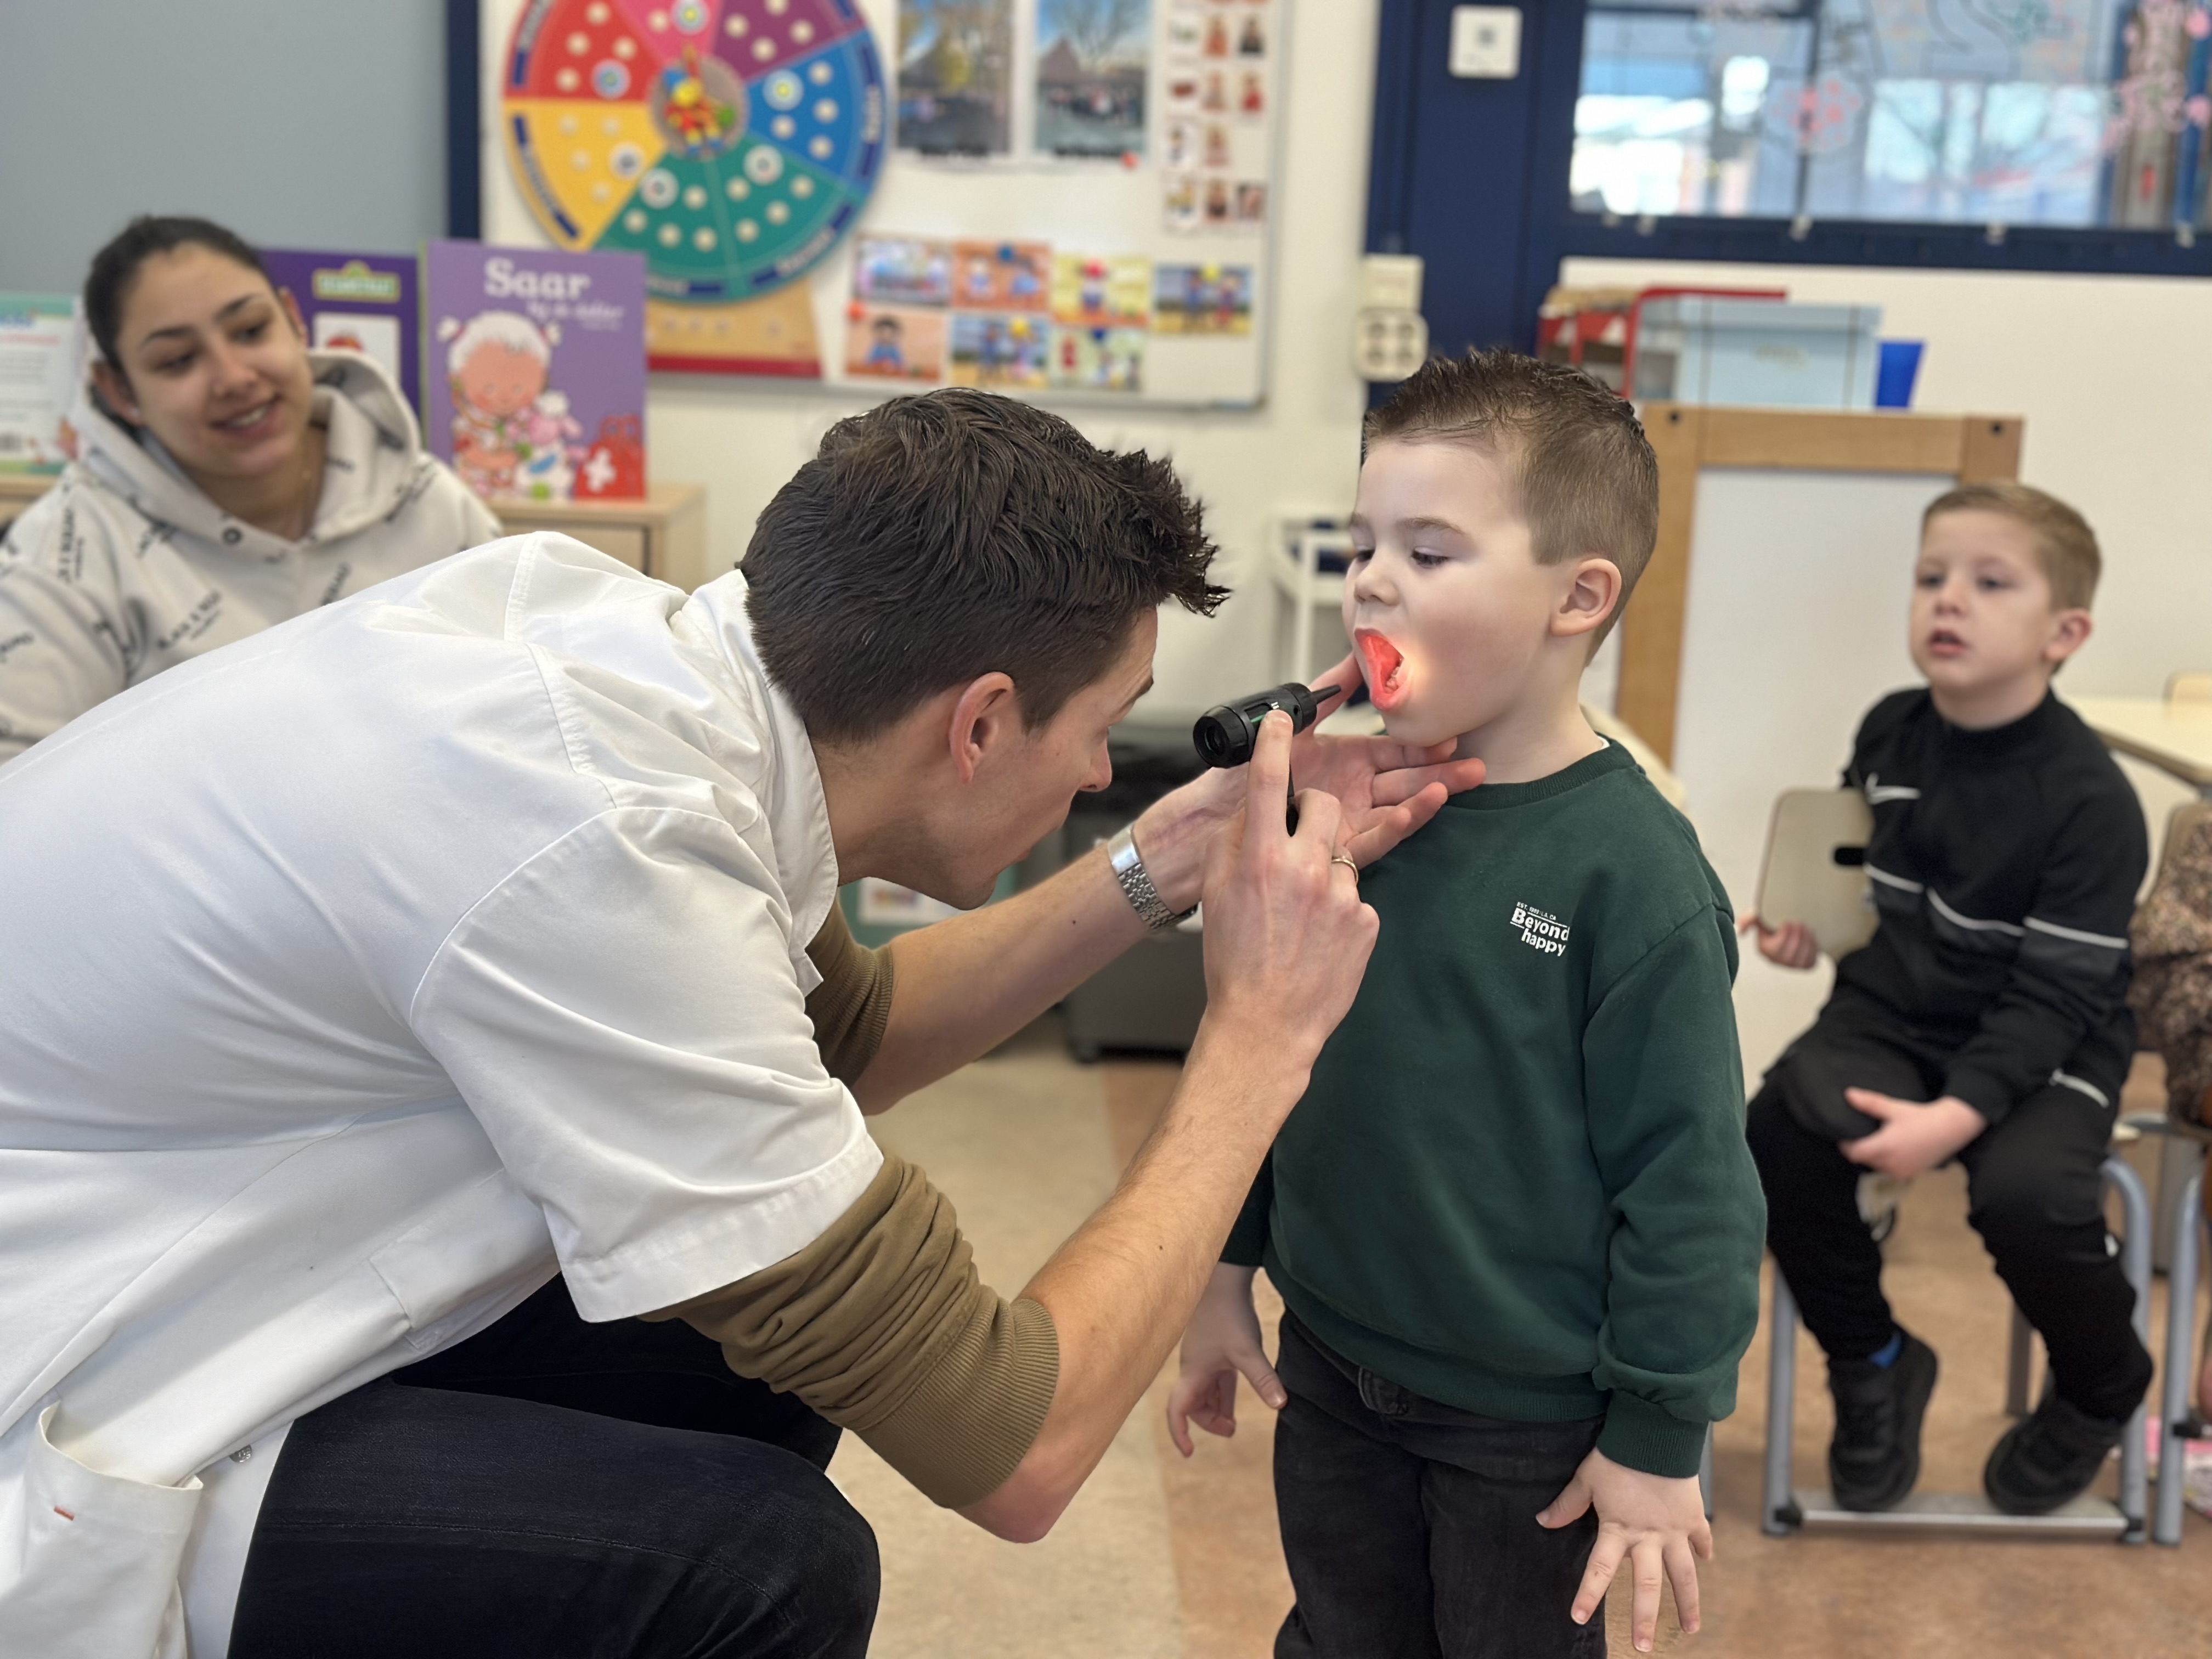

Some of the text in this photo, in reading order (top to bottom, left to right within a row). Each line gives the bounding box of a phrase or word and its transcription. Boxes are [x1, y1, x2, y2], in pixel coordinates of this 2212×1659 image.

[483, 255, 592, 300] Saar
[1511, 907, 1570, 941] Beyond
[1521, 928, 1566, 957] happy
